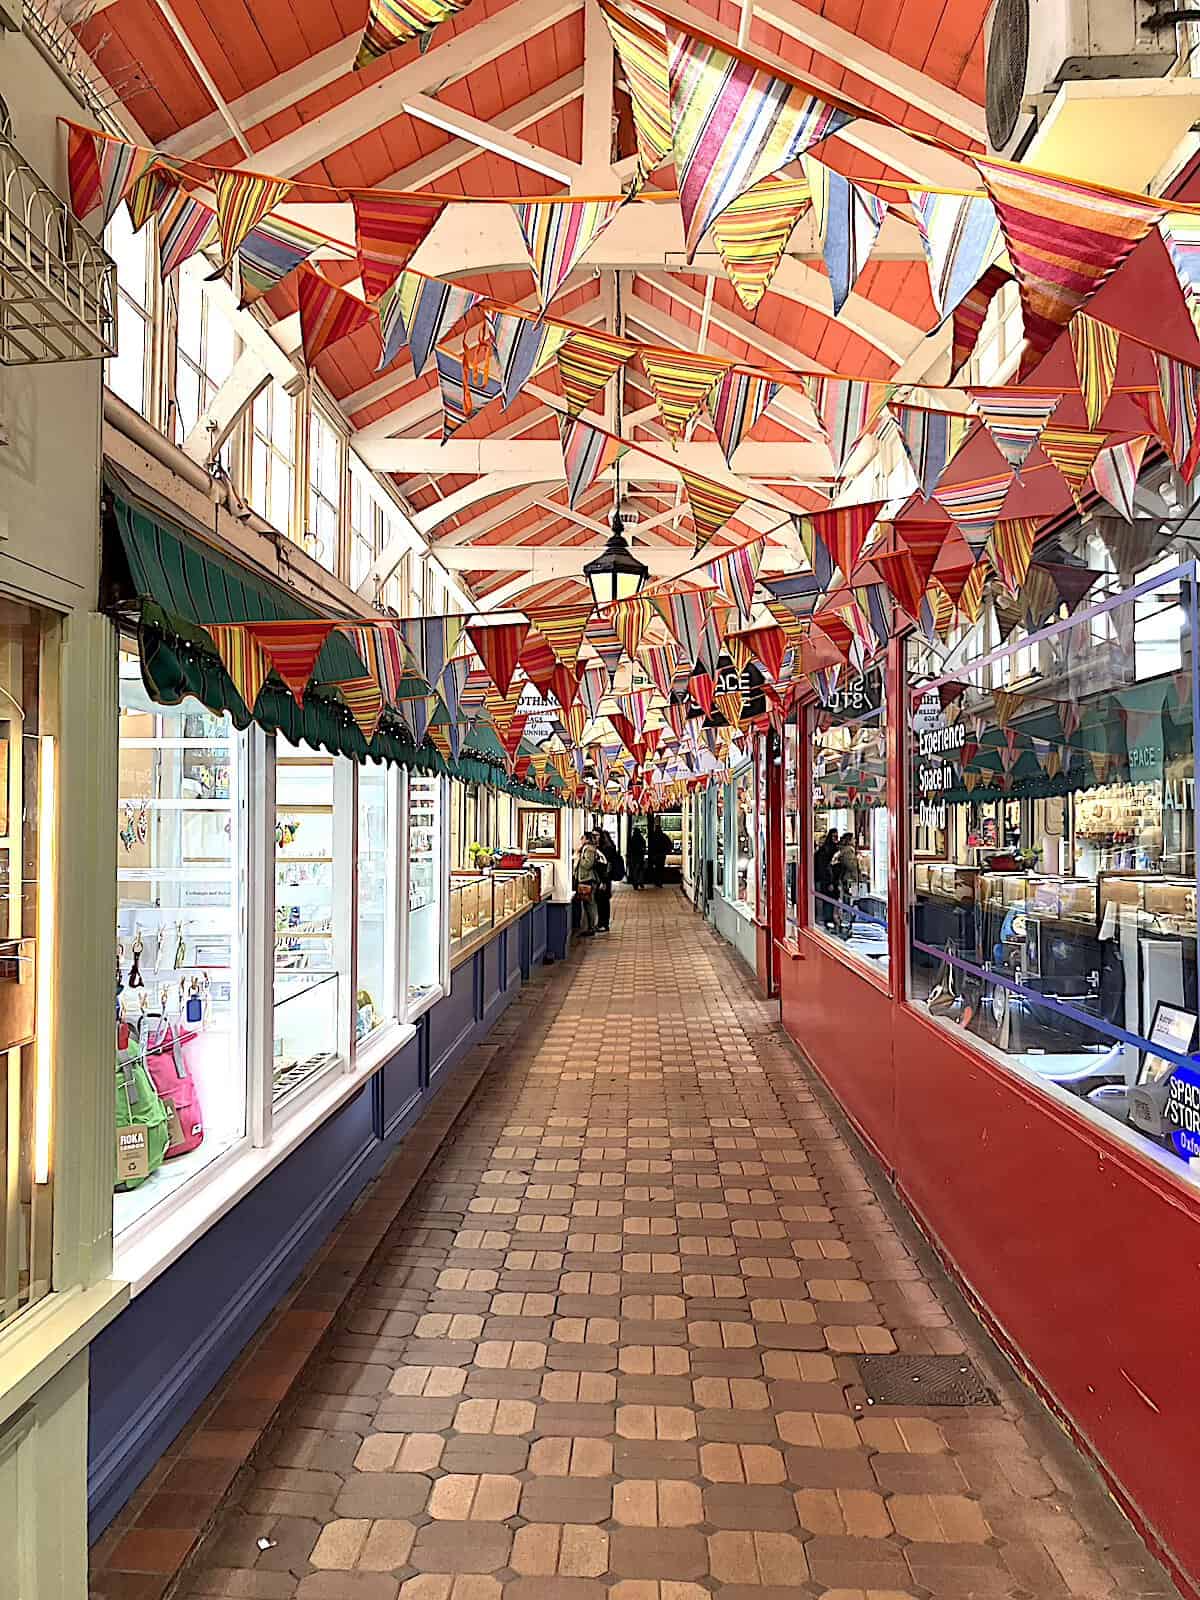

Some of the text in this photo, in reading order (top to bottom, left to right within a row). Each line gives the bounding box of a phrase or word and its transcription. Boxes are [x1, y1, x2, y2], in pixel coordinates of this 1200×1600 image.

[919, 723, 965, 756] Experience
[1129, 747, 1155, 767] SPACE
[919, 759, 953, 798] Space in
[919, 798, 946, 830] Oxford
[119, 1132, 144, 1145] ROKA
